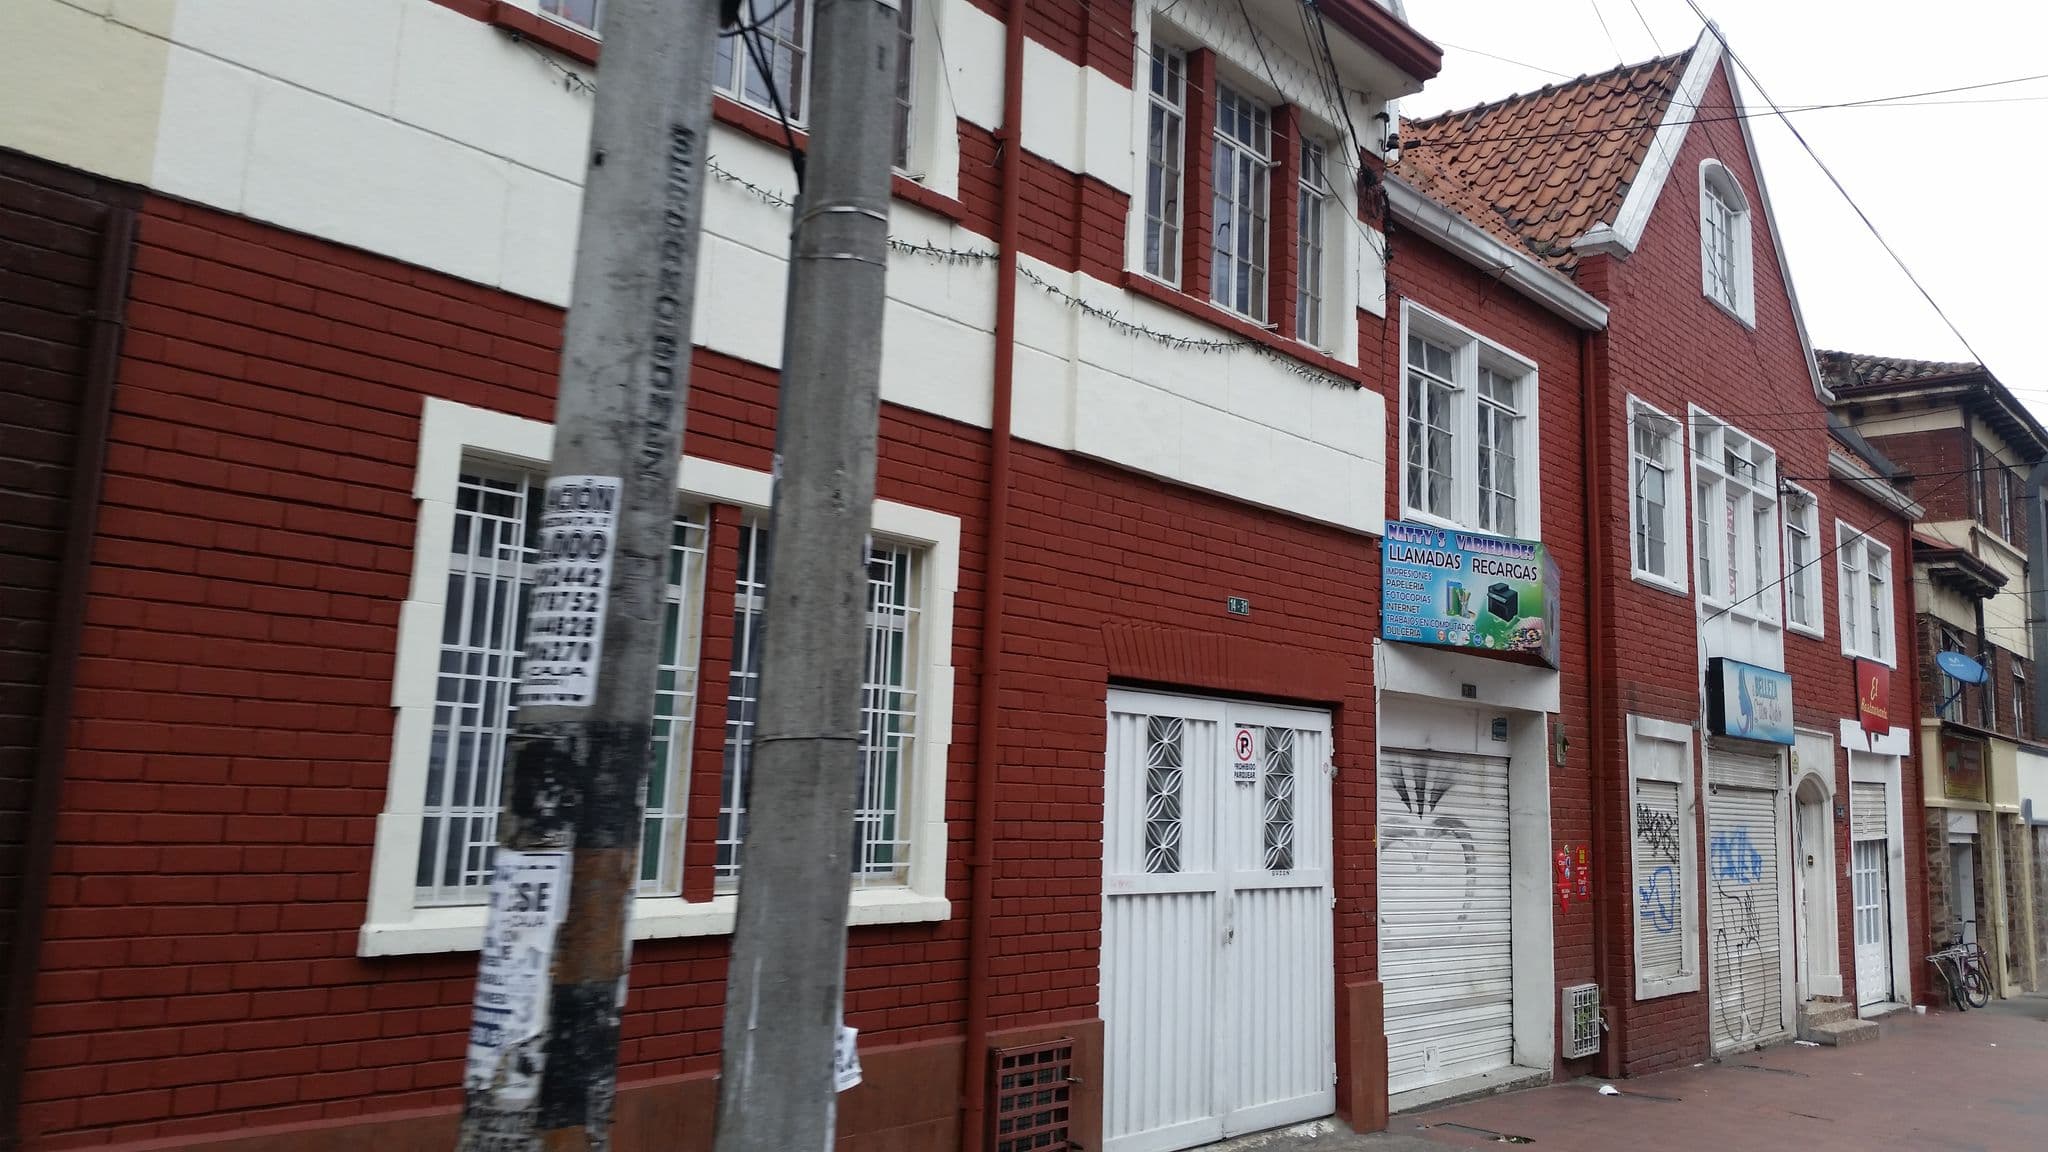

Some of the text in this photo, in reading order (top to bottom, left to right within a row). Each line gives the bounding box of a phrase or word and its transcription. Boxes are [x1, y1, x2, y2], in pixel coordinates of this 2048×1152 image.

[1387, 524, 1536, 561] NATTY'S VARIEDADES
[1389, 545, 1538, 581] LLAMADAS RECARGAS
[1386, 567, 1432, 580] IMPRESIONES
[1386, 579, 1425, 591] PAPELERIA
[1386, 591, 1431, 603] FOTOCOPIAS
[1386, 603, 1420, 614] INTERNET
[1387, 615, 1418, 626] TRABAJOS
[1386, 626, 1421, 637] DULCERIA
[1234, 763, 1256, 771] PROHIBIDO
[1234, 771, 1256, 780] PARQUEAR
